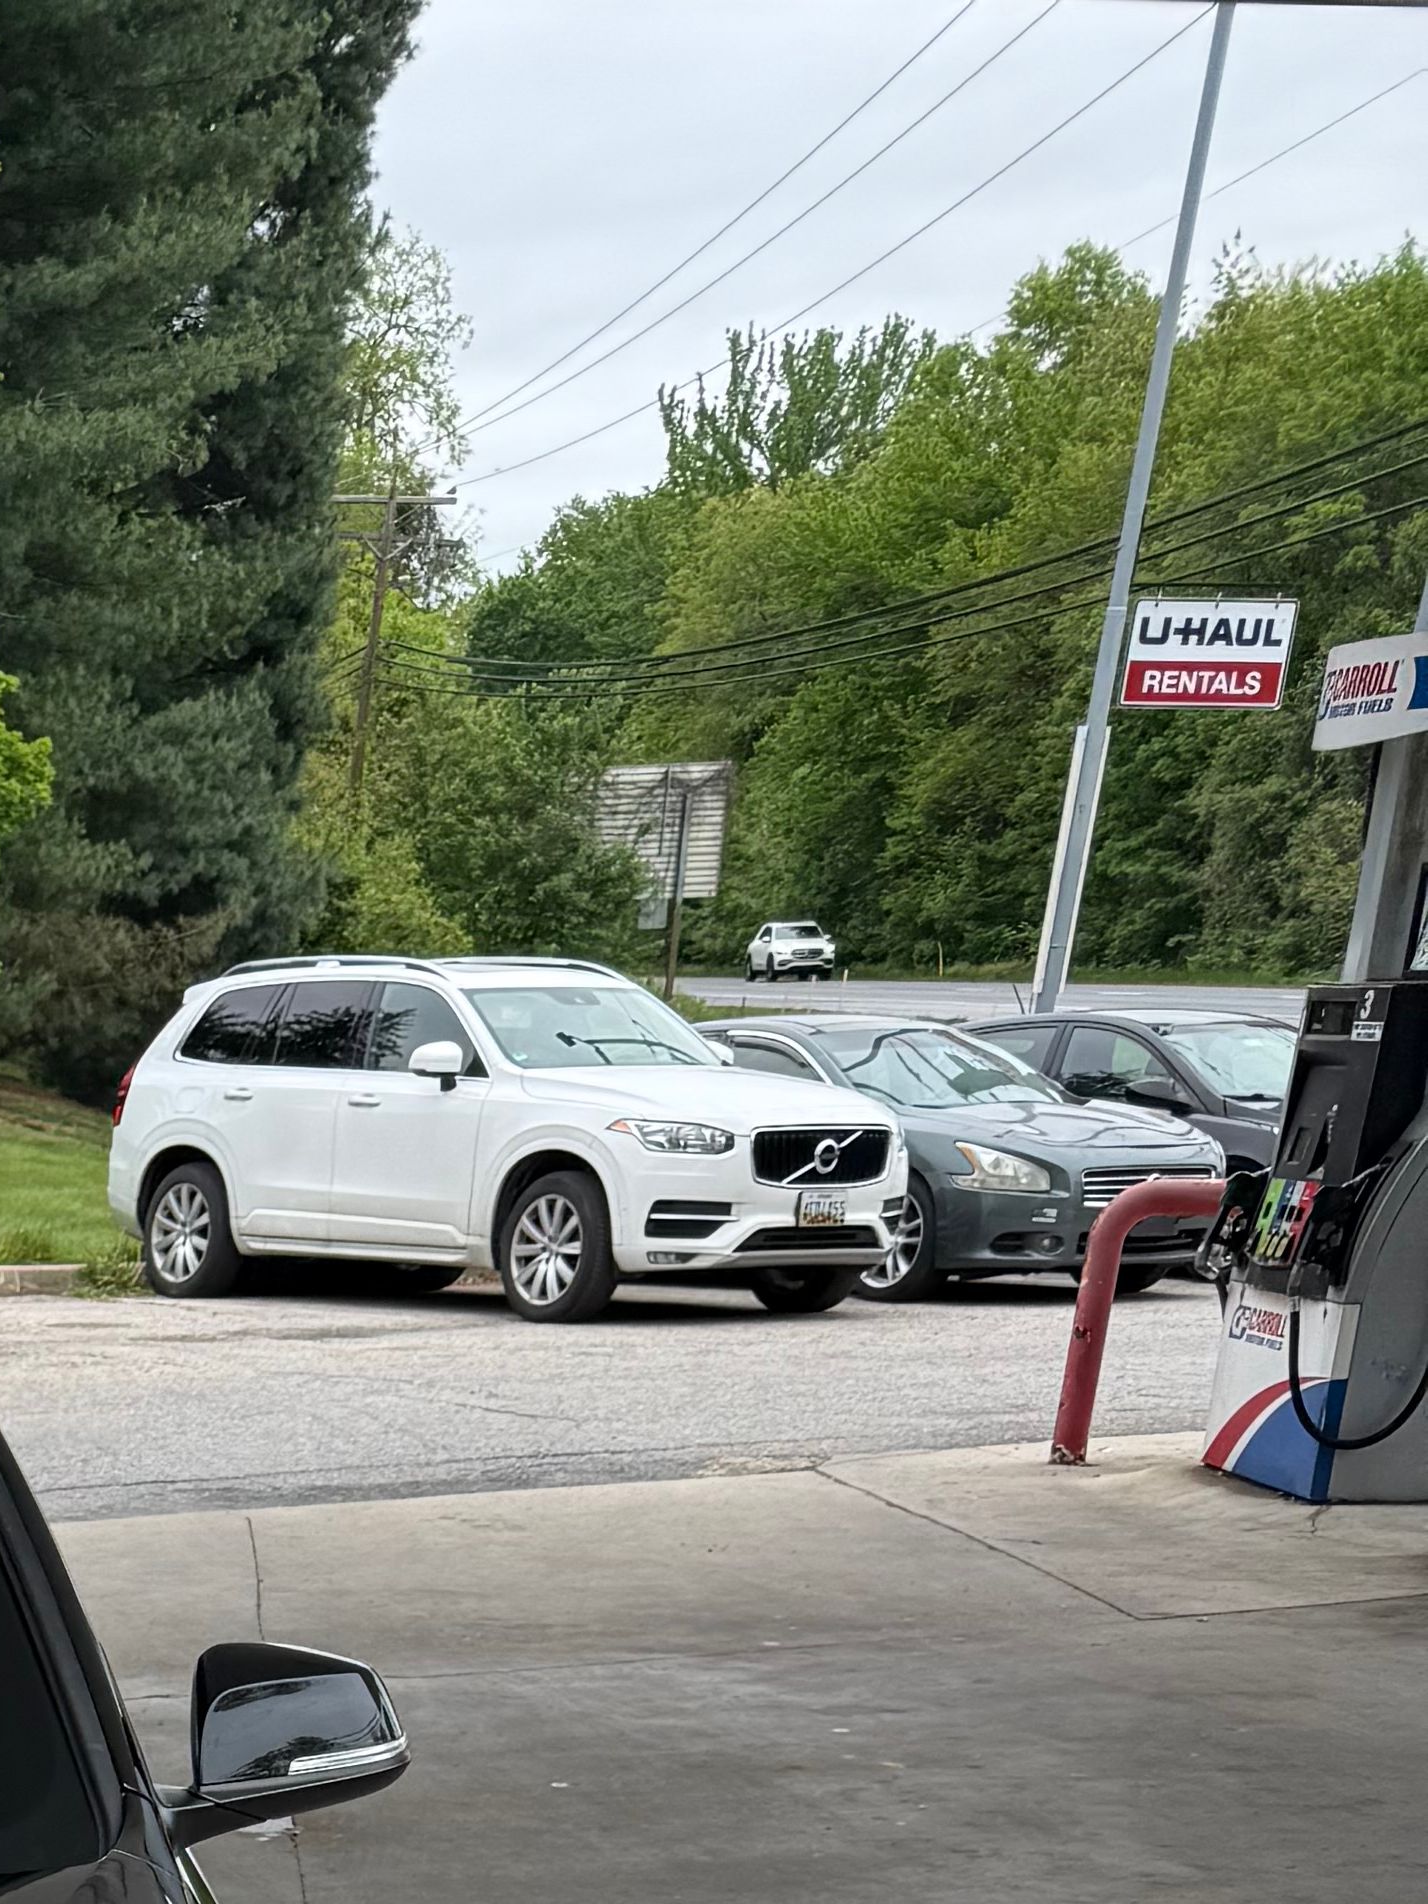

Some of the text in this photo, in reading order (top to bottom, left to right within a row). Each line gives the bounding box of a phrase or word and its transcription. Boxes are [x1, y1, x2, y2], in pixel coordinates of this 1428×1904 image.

[1139, 616, 1283, 648] U-HAUL
[1142, 670, 1262, 696] RENTALS
[1332, 660, 1400, 702] CARROLL
[1359, 989, 1375, 1019] 3
